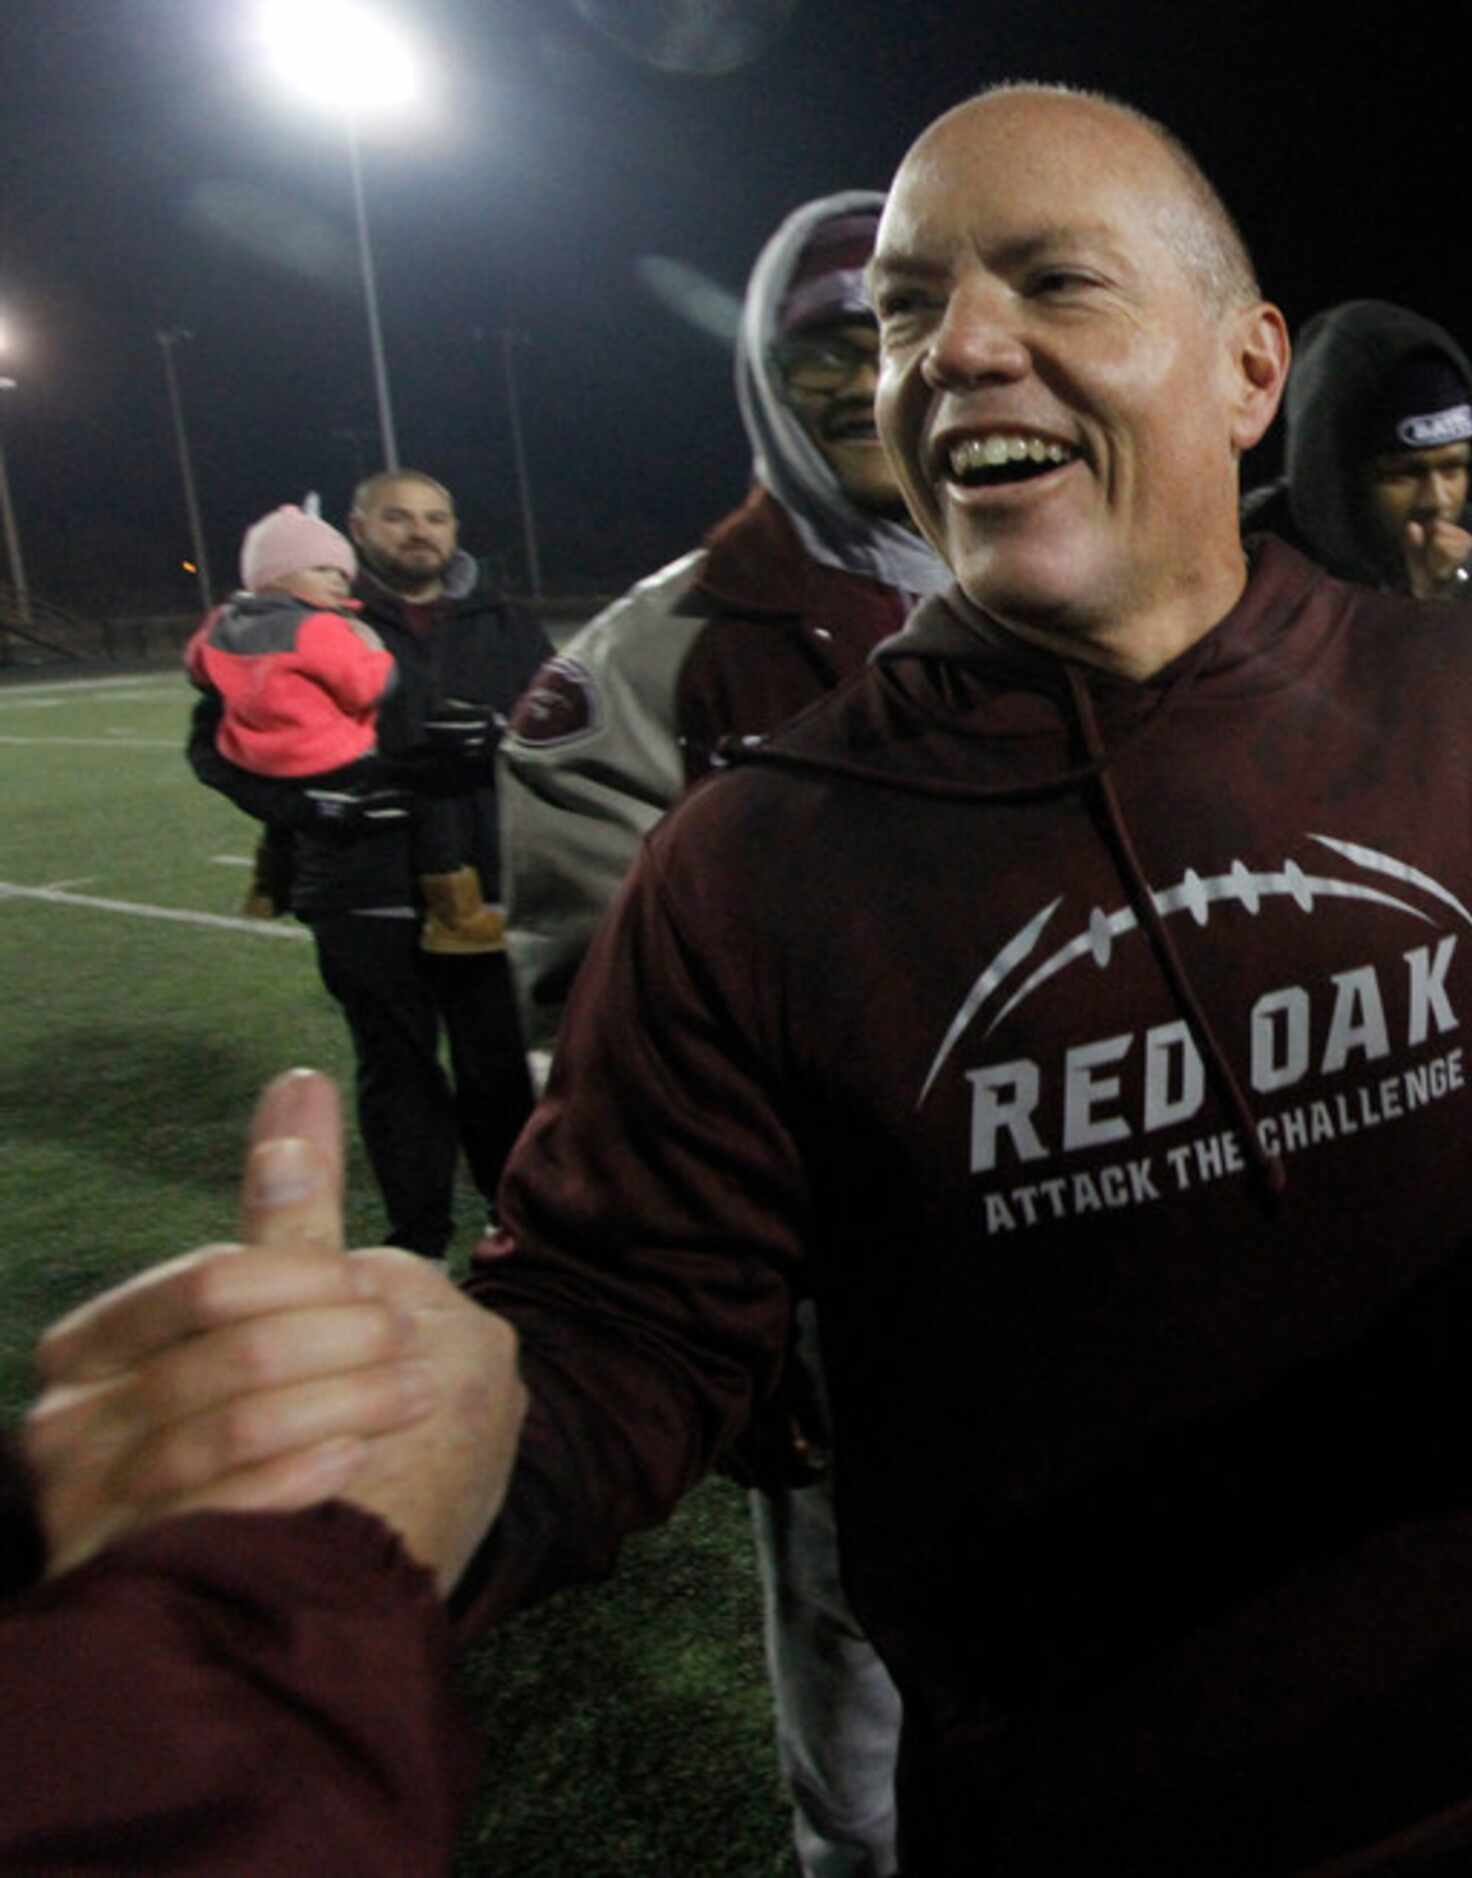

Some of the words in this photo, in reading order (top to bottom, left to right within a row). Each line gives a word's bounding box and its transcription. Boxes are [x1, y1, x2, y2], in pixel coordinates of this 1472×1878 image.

[964, 1019, 1206, 1174] RED
[1251, 934, 1460, 1094] OAK
[984, 1159, 1159, 1235] ATTACK
[1168, 1130, 1244, 1190] THE
[1256, 1048, 1466, 1157] CHALLENGE
